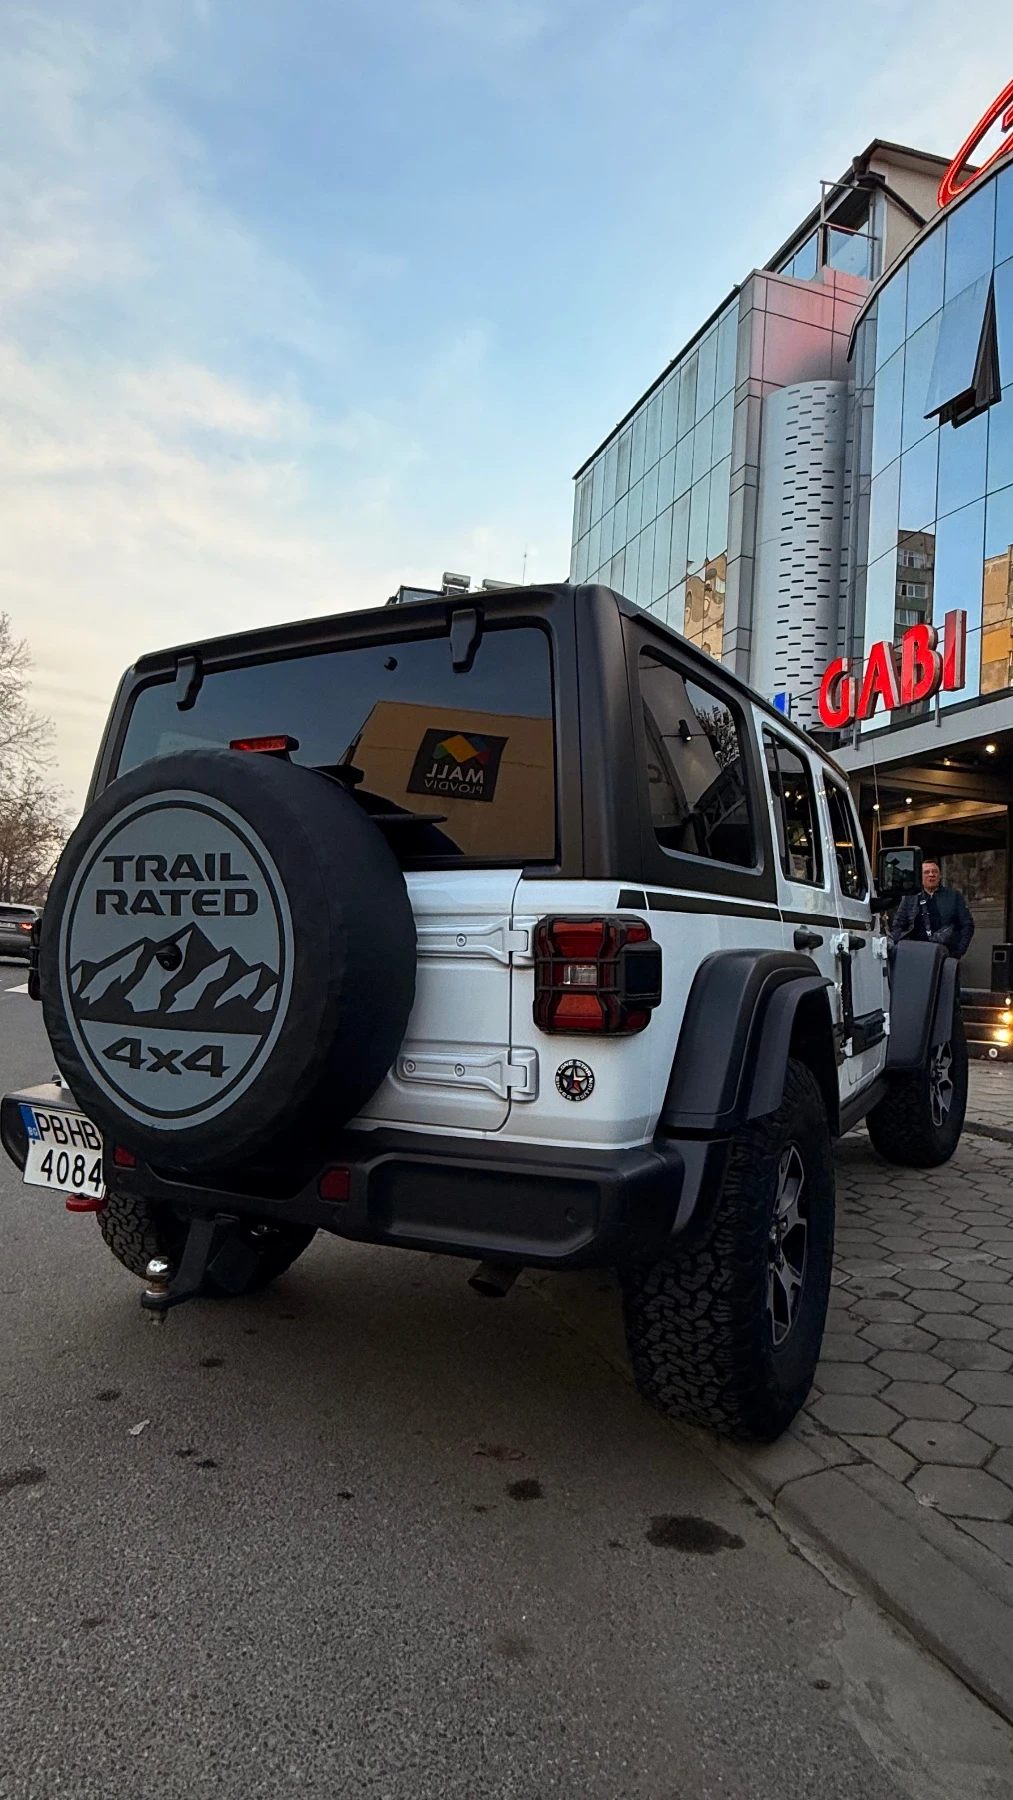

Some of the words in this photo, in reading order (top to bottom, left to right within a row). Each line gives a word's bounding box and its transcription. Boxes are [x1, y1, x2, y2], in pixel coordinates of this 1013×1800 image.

[818, 609, 967, 728] GABI
[102, 853, 249, 882] TRAIL
[96, 889, 258, 916] RATED
[102, 1036, 231, 1078] 4x4
[557, 1060, 574, 1075] LONE
[575, 1060, 592, 1077] STAR
[27, 1126, 39, 1137] BG
[34, 1111, 101, 1150] PBHB
[40, 1148, 101, 1192] 4084
